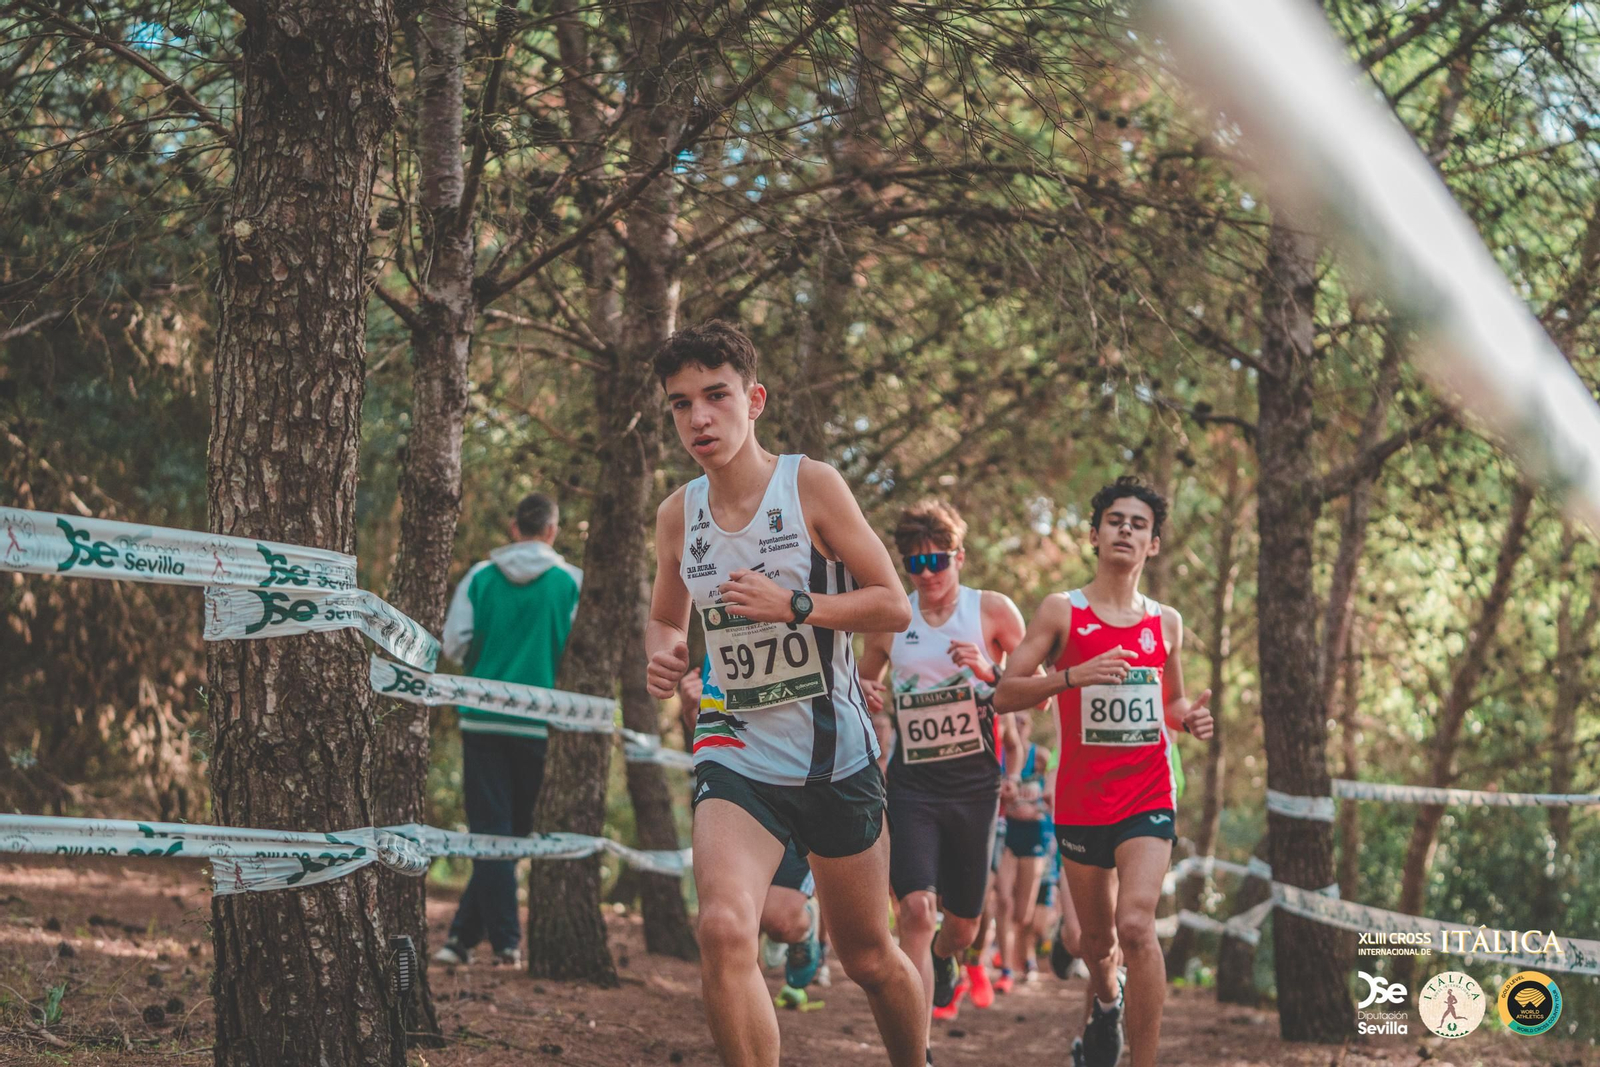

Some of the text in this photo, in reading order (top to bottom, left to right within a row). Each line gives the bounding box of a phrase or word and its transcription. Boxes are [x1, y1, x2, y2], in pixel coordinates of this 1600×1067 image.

[758, 533, 798, 546] Ayuntamiento
[768, 541, 800, 553] Salamanca
[124, 552, 185, 576] Sevilla
[697, 563, 717, 572] RURAL
[719, 632, 810, 680] 5970
[1090, 698, 1158, 723] 8061
[908, 712, 975, 742] 6042
